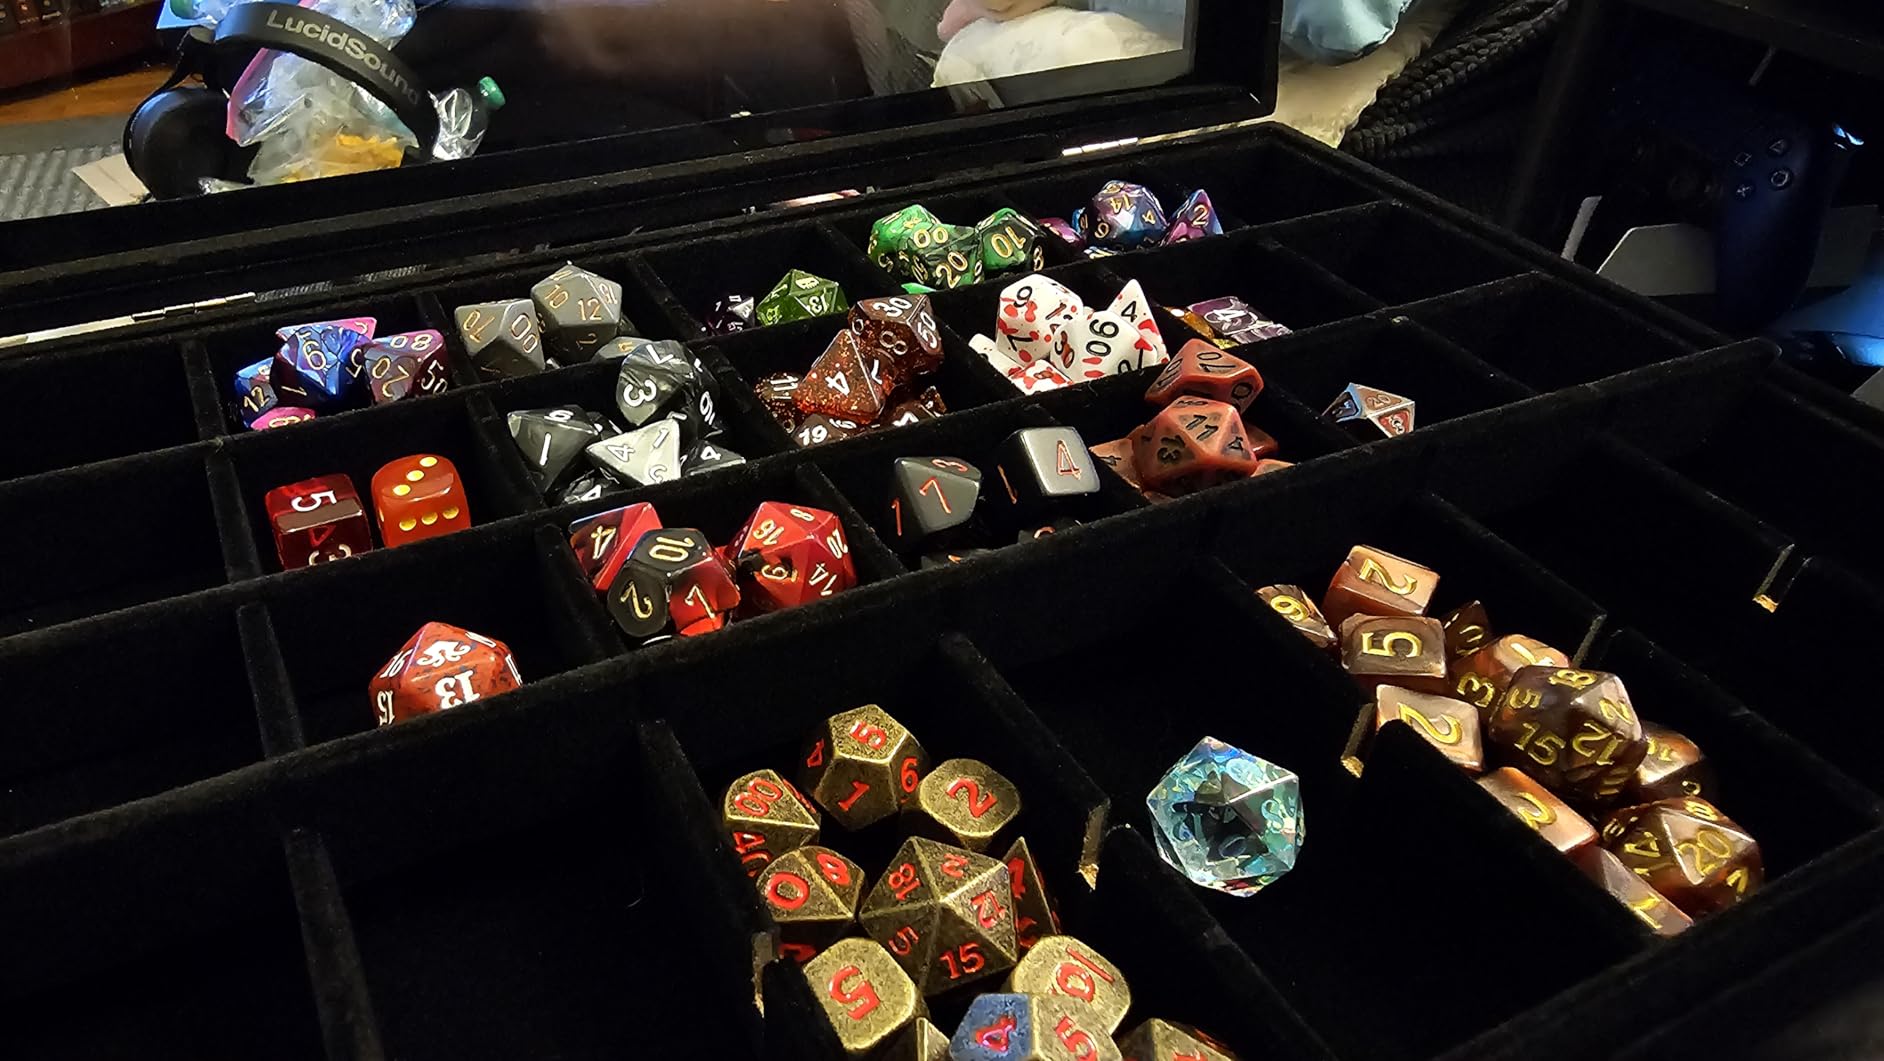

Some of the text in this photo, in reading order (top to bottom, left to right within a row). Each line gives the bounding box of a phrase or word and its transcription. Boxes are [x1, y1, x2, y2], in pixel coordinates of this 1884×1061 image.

[1142, 209, 1157, 225] 4
[1191, 204, 1209, 226] 2
[991, 226, 1027, 258] 10
[935, 251, 968, 289] 20
[544, 284, 569, 310] 10
[578, 298, 603, 321] 12
[872, 297, 912, 317] 30
[1121, 301, 1138, 323] 4
[917, 311, 937, 349] 50
[243, 386, 270, 413] 12
[623, 379, 658, 408] 3
[825, 371, 851, 398] 4
[652, 428, 670, 449] 1
[799, 425, 828, 446] 19
[1185, 414, 1220, 443] 11
[1226, 436, 1245, 453] 4
[607, 445, 635, 463] 4
[701, 446, 722, 461] 4
[1056, 439, 1083, 481] 4
[1157, 435, 1187, 465] 13
[291, 490, 337, 512] 5
[919, 477, 952, 515] 7
[790, 508, 815, 522] 8
[891, 498, 902, 536] 1
[590, 525, 617, 560] 4
[648, 536, 696, 562] 10
[808, 563, 839, 597] 14
[1358, 558, 1419, 596] 2
[620, 580, 654, 619] 2
[1361, 631, 1423, 659] 5
[434, 670, 481, 709] 13
[1456, 671, 1496, 709] 3
[1509, 688, 1544, 710] 5
[850, 720, 888, 751] 5
[1397, 702, 1463, 746] 2
[806, 738, 825, 768] 4
[1514, 722, 1567, 766] 15
[838, 779, 871, 812] 1
[946, 778, 998, 819] 2
[815, 853, 852, 886] 8
[1677, 829, 1733, 878] 20
[765, 871, 811, 911] 0
[888, 863, 921, 901] 18
[1007, 857, 1026, 900] 1
[970, 890, 1007, 929] 12
[888, 926, 919, 956] 5
[940, 942, 985, 980] 15
[829, 965, 881, 1021] 5
[973, 1013, 1018, 1054] 4
[1054, 1013, 1098, 1061] 5
